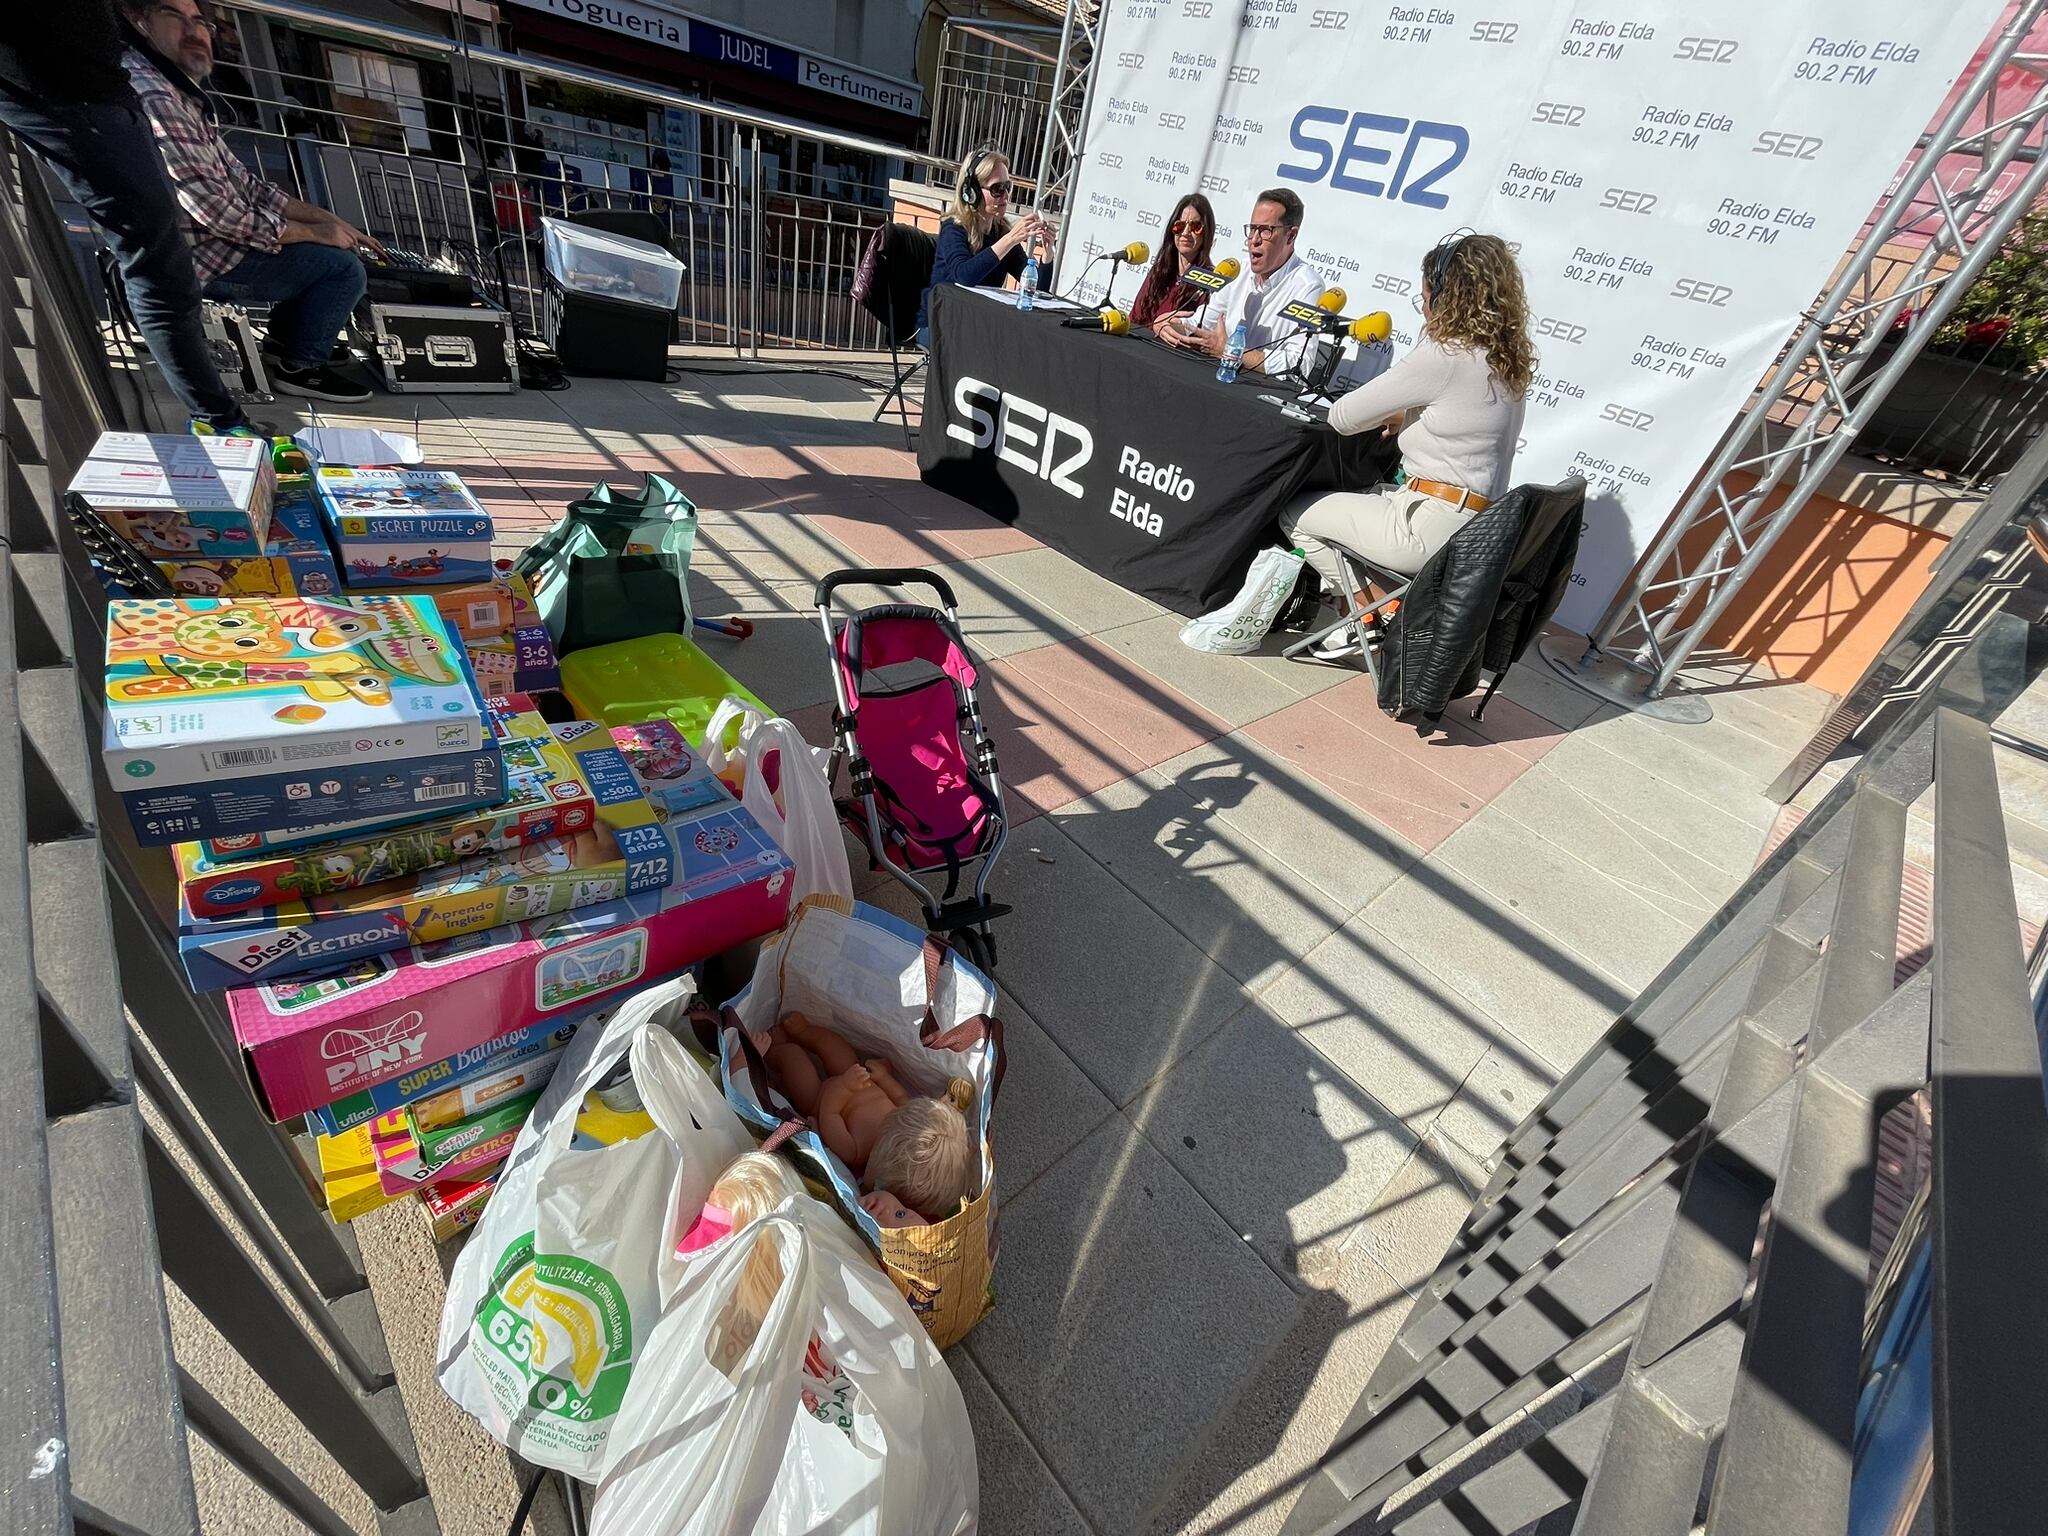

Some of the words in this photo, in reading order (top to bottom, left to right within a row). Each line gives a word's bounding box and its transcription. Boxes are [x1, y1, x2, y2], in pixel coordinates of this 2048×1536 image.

[549, 0, 680, 43] ogueria
[1182, 2, 1213, 19] SER
[1310, 10, 1348, 30] SER
[1389, 7, 1424, 22] Radio
[1427, 9, 1455, 25] Elda
[1242, 15, 1262, 28] 90.2
[1263, 17, 1280, 30] FM
[1469, 21, 1518, 43] SER
[1570, 19, 1615, 37] Radio
[1618, 22, 1655, 40] Elda
[1383, 26, 1408, 41] 90.2
[1410, 28, 1431, 43] FM
[1117, 52, 1144, 70] SER
[1172, 52, 1195, 66] Radio
[1197, 55, 1217, 68] Elda
[1561, 40, 1595, 58] 90.2
[1596, 42, 1624, 60] FM
[1673, 37, 1739, 64] SER
[1807, 37, 1867, 58] Radio
[1871, 42, 1920, 63] Elda
[720, 34, 772, 70] JUDEL
[806, 60, 913, 110] Perfumeria
[1169, 67, 1185, 80] 90.2
[1187, 70, 1201, 82] FM
[1228, 66, 1260, 85] SER
[1794, 61, 1839, 82] 90.2
[1840, 66, 1877, 85] FM
[1109, 98, 1130, 111] Radio
[1132, 102, 1148, 114] Elda
[1532, 102, 1586, 127] SER
[1107, 112, 1122, 123] 90.2
[1123, 115, 1135, 126] FM
[1158, 112, 1185, 130] SER
[1216, 115, 1241, 130] Radio
[1243, 121, 1263, 134] Elda
[1642, 105, 1690, 126] Radio
[1694, 112, 1734, 133] Elda
[1212, 130, 1230, 144] 90.2
[1232, 134, 1248, 146] FM
[1632, 127, 1668, 145] 90.2
[1670, 132, 1700, 150] FM
[1752, 131, 1823, 160] SER
[1149, 157, 1170, 171] Radio
[1172, 161, 1189, 175] Elda
[1277, 104, 1470, 211] SER
[1146, 170, 1161, 183] 90.2
[1163, 174, 1176, 186] FM
[1200, 175, 1229, 193] SER
[1508, 163, 1548, 182] Radio
[1551, 170, 1583, 188] Elda
[1500, 181, 1530, 198] 90.2
[1531, 187, 1556, 203] FM
[1600, 188, 1658, 214] SER
[1718, 198, 1770, 221] Radio
[1773, 208, 1816, 229] Elda
[1707, 219, 1745, 238] 90.2
[1747, 226, 1780, 244] FM
[1307, 249, 1336, 266] Radio
[1337, 257, 1360, 272] Elda
[1572, 247, 1615, 268] Radio
[1618, 256, 1653, 276] Elda
[1184, 270, 1225, 289] SER
[1324, 268, 1341, 282] FM
[1371, 273, 1411, 297] SER
[1563, 265, 1595, 283] 90.2
[1597, 271, 1624, 289] FM
[1670, 278, 1733, 307] SER
[1536, 318, 1587, 344] SER
[1640, 335, 1687, 357] Radio
[1690, 348, 1727, 368] Elda
[1631, 353, 1665, 371] 90.2
[1667, 361, 1695, 379] FM
[1532, 374, 1551, 388] dio
[1554, 380, 1585, 399] Elda
[1536, 393, 1559, 408] FM
[1600, 403, 1654, 432] SER
[946, 376, 1094, 499] SER
[357, 471, 401, 479] SECRET
[408, 471, 450, 480] PUZZLE
[1118, 446, 1195, 502] Radio
[1574, 451, 1615, 473] Radio
[1618, 466, 1650, 486] Elda
[1598, 478, 1623, 493] FM
[1109, 488, 1163, 538] Elda
[372, 521, 415, 533] SECRET
[421, 520, 463, 532] PUZZLE
[560, 720, 596, 740] Diset
[590, 772, 605, 780] 18
[627, 840, 666, 854] años
[212, 883, 260, 900] Disney
[630, 874, 667, 890] años
[431, 901, 494, 922] Aprendo
[446, 913, 485, 929] Ingles
[238, 929, 303, 968] Diset
[296, 924, 400, 957] LECTRON
[325, 1032, 427, 1086] PINY
[330, 1075, 370, 1093] INSTITUTE
[372, 1068, 382, 1078] OF
[384, 1061, 401, 1074] NEW
[404, 1054, 423, 1066] YORK
[397, 1060, 452, 1096] SUPER
[337, 1106, 376, 1128] vilac
[436, 1126, 482, 1152] CREATIVE
[535, 1263, 593, 1287] UTILITZABLE
[489, 1309, 533, 1363] 65
[472, 1339, 498, 1372] RECYCLED
[497, 1369, 522, 1403] MATERIAL
[558, 1426, 607, 1441] RECICLADO
[560, 1437, 599, 1452] RECICLAT
